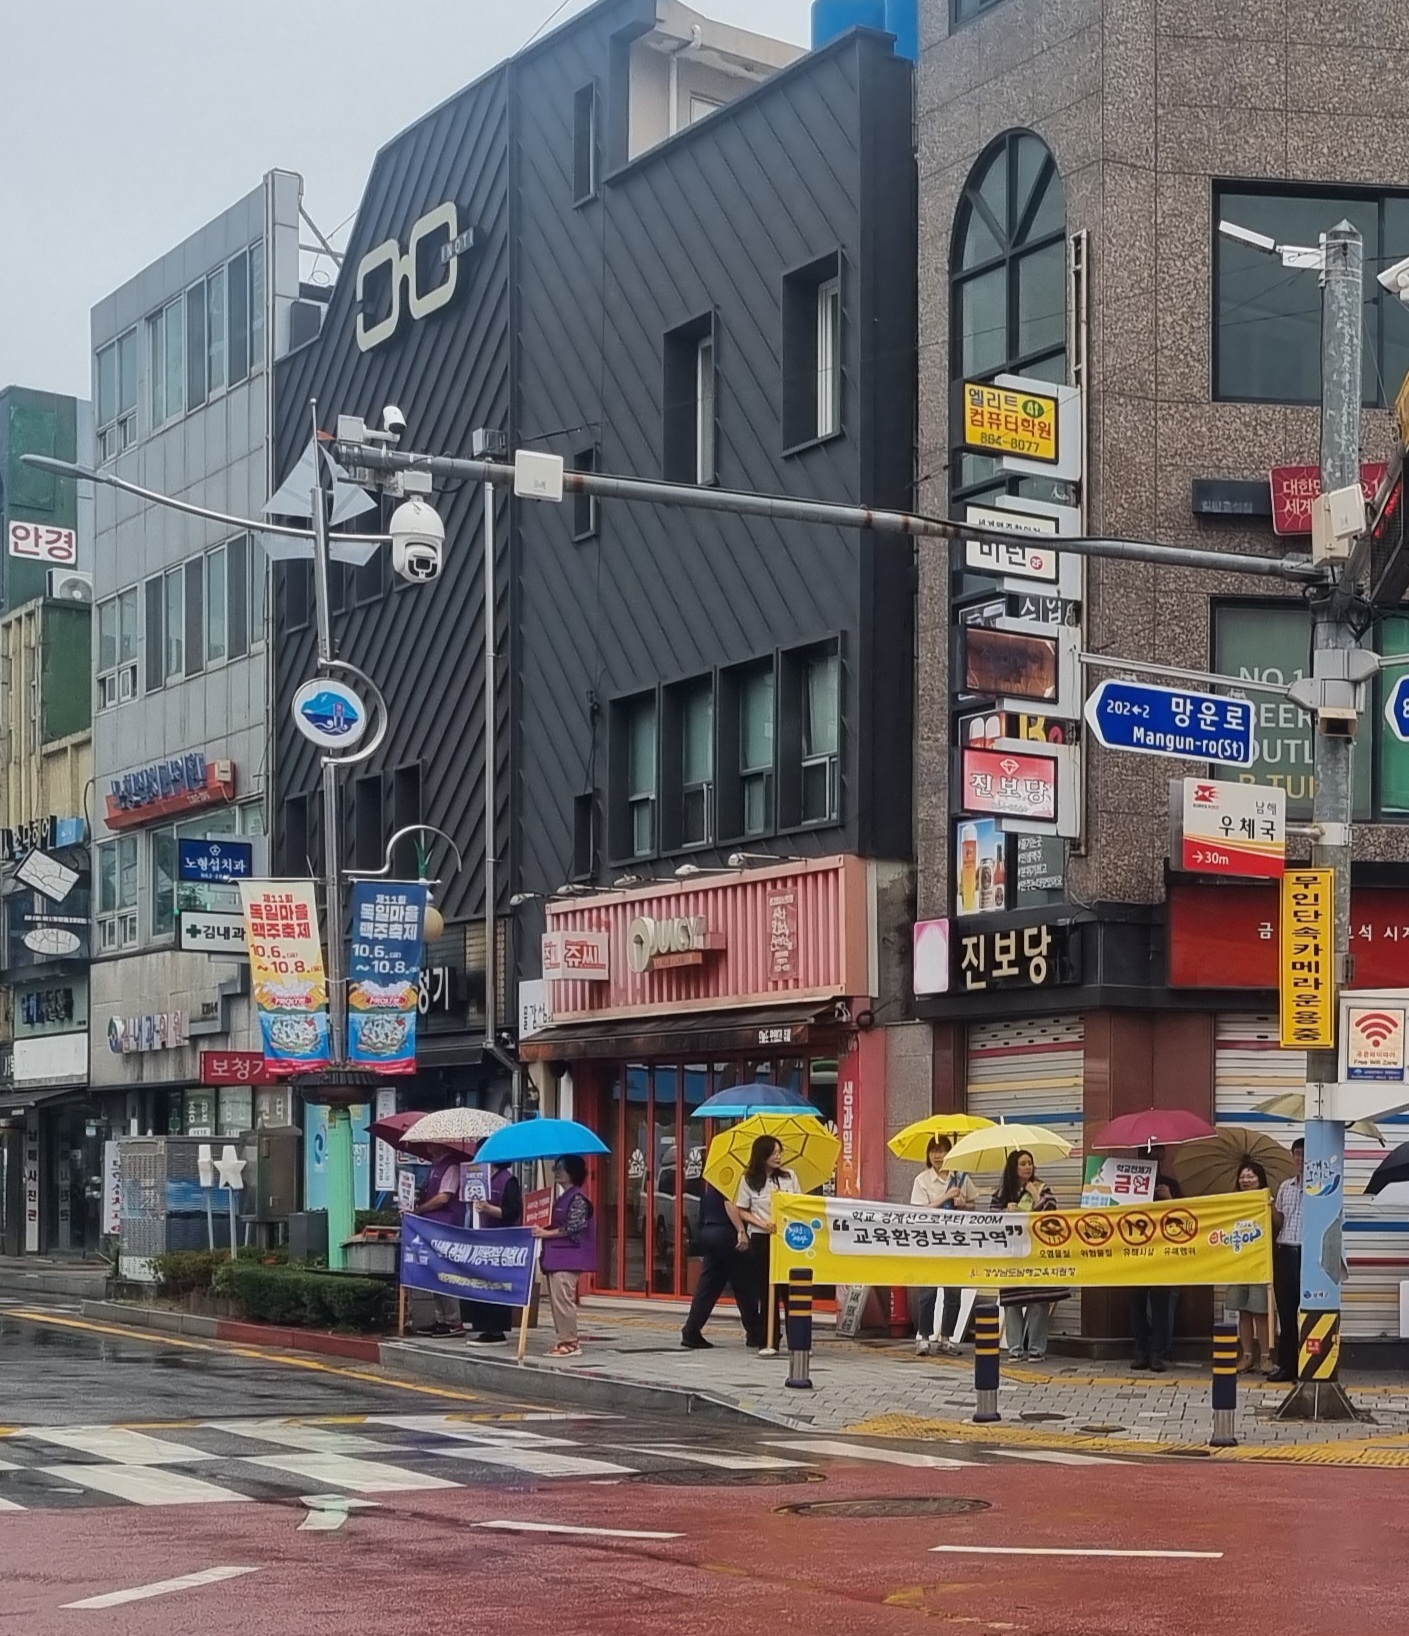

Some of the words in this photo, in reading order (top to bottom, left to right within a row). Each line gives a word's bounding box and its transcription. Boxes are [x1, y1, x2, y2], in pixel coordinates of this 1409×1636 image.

[969, 388, 1018, 413] 엘리트
[969, 408, 1052, 440] 컴퓨터학원
[981, 432, 1040, 453] 864-8077
[1171, 697, 1244, 731] 망운로
[1254, 703, 1312, 728] EER
[1133, 726, 1244, 761] Mangun-ro(St)
[1255, 801, 1277, 815] 남해
[1218, 816, 1276, 842] 우체국
[185, 857, 246, 873] 노형섭치과
[250, 904, 308, 921] 독일마을
[360, 904, 419, 922] 독일마을
[251, 922, 311, 939] 맥주축제
[359, 922, 417, 940] 맥주축제
[1258, 922, 1274, 939] 금
[564, 945, 598, 968] 쥬씨
[961, 925, 1051, 990] 진보당
[1114, 1174, 1150, 1195] 금연
[852, 1211, 875, 1223] 학교
[880, 1212, 964, 1225] 경계선으로부터
[969, 1215, 1003, 1225] 200M
